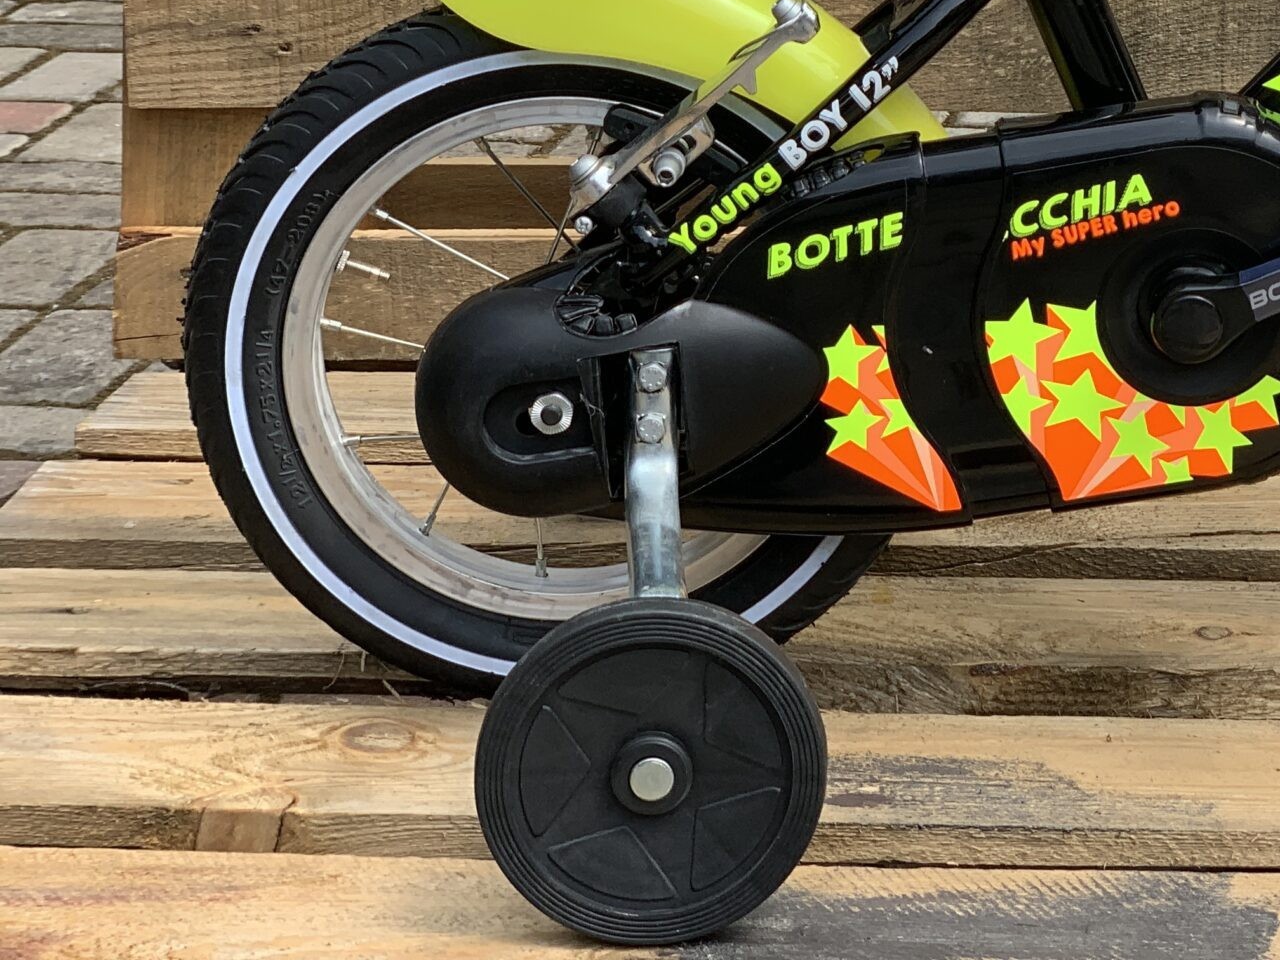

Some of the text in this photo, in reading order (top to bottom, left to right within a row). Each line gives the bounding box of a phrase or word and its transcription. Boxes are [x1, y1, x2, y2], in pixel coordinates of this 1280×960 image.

[668, 162, 782, 255] Young
[778, 99, 848, 171] BOY
[1011, 201, 1181, 261] My SUPER hero
